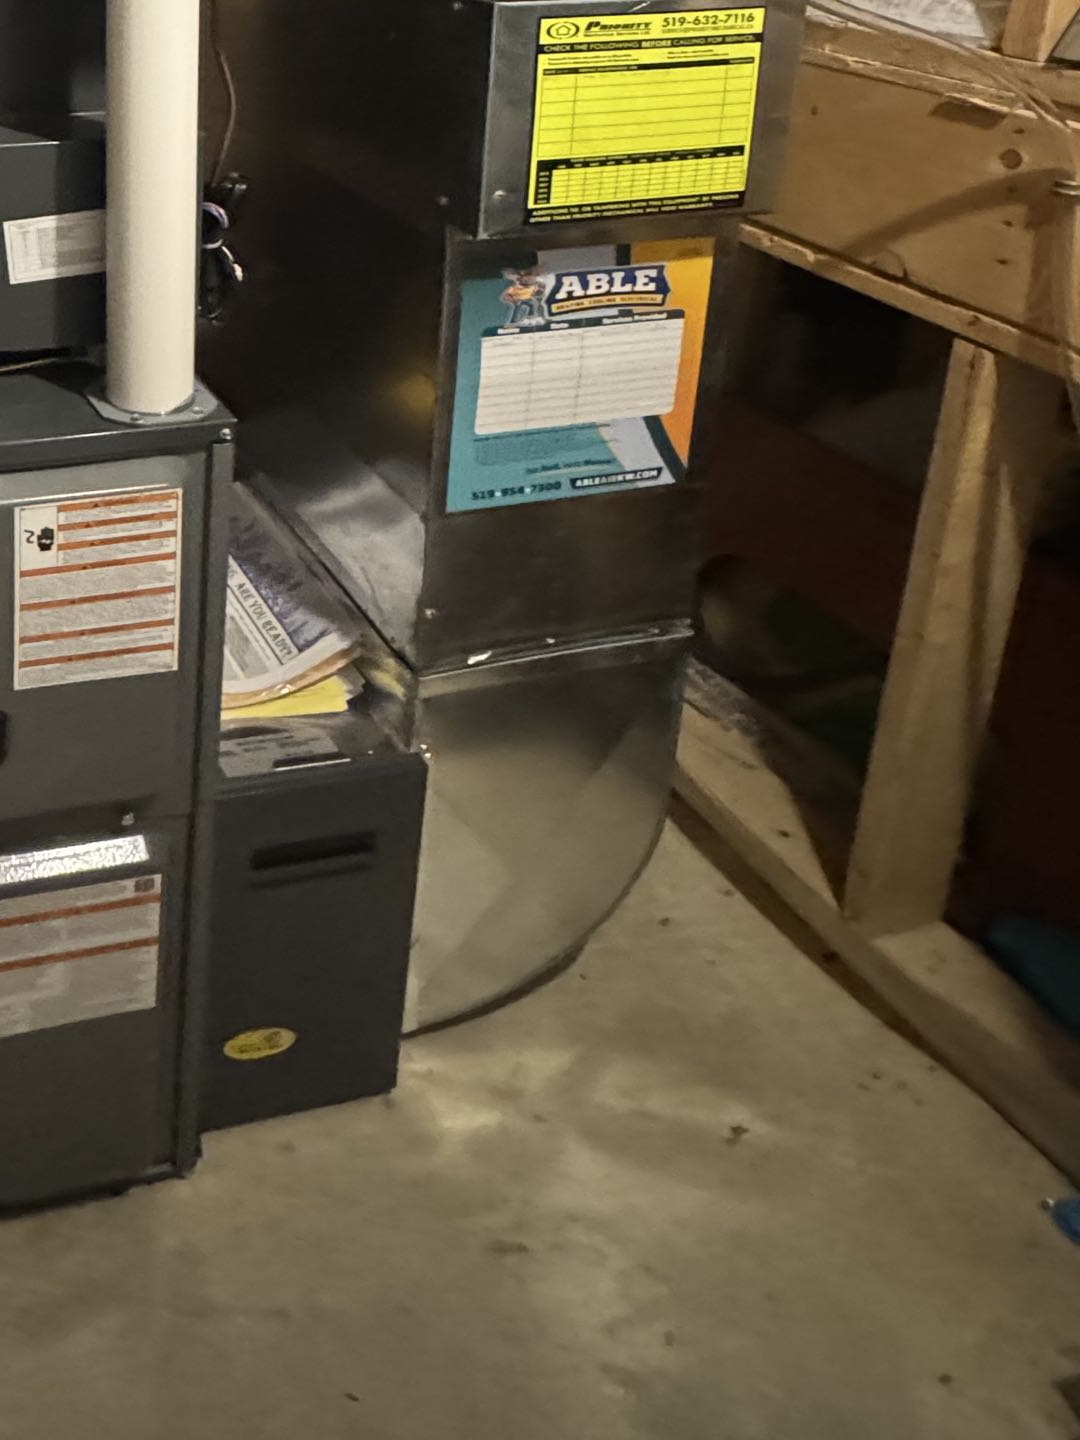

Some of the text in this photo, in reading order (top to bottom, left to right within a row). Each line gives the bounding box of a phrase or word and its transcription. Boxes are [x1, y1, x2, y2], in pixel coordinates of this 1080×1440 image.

[585, 21, 652, 31] PRIORITY
[662, 13, 755, 28] 519-632-7116
[544, 44, 571, 52] CHECK
[573, 43, 588, 51] THE
[589, 41, 639, 50] FOLLOWING
[641, 40, 672, 48] BEFORE
[673, 38, 706, 46] CALLING
[555, 269, 658, 299] ABLE
[236, 582, 255, 600] ARE
[249, 600, 267, 621] YOU
